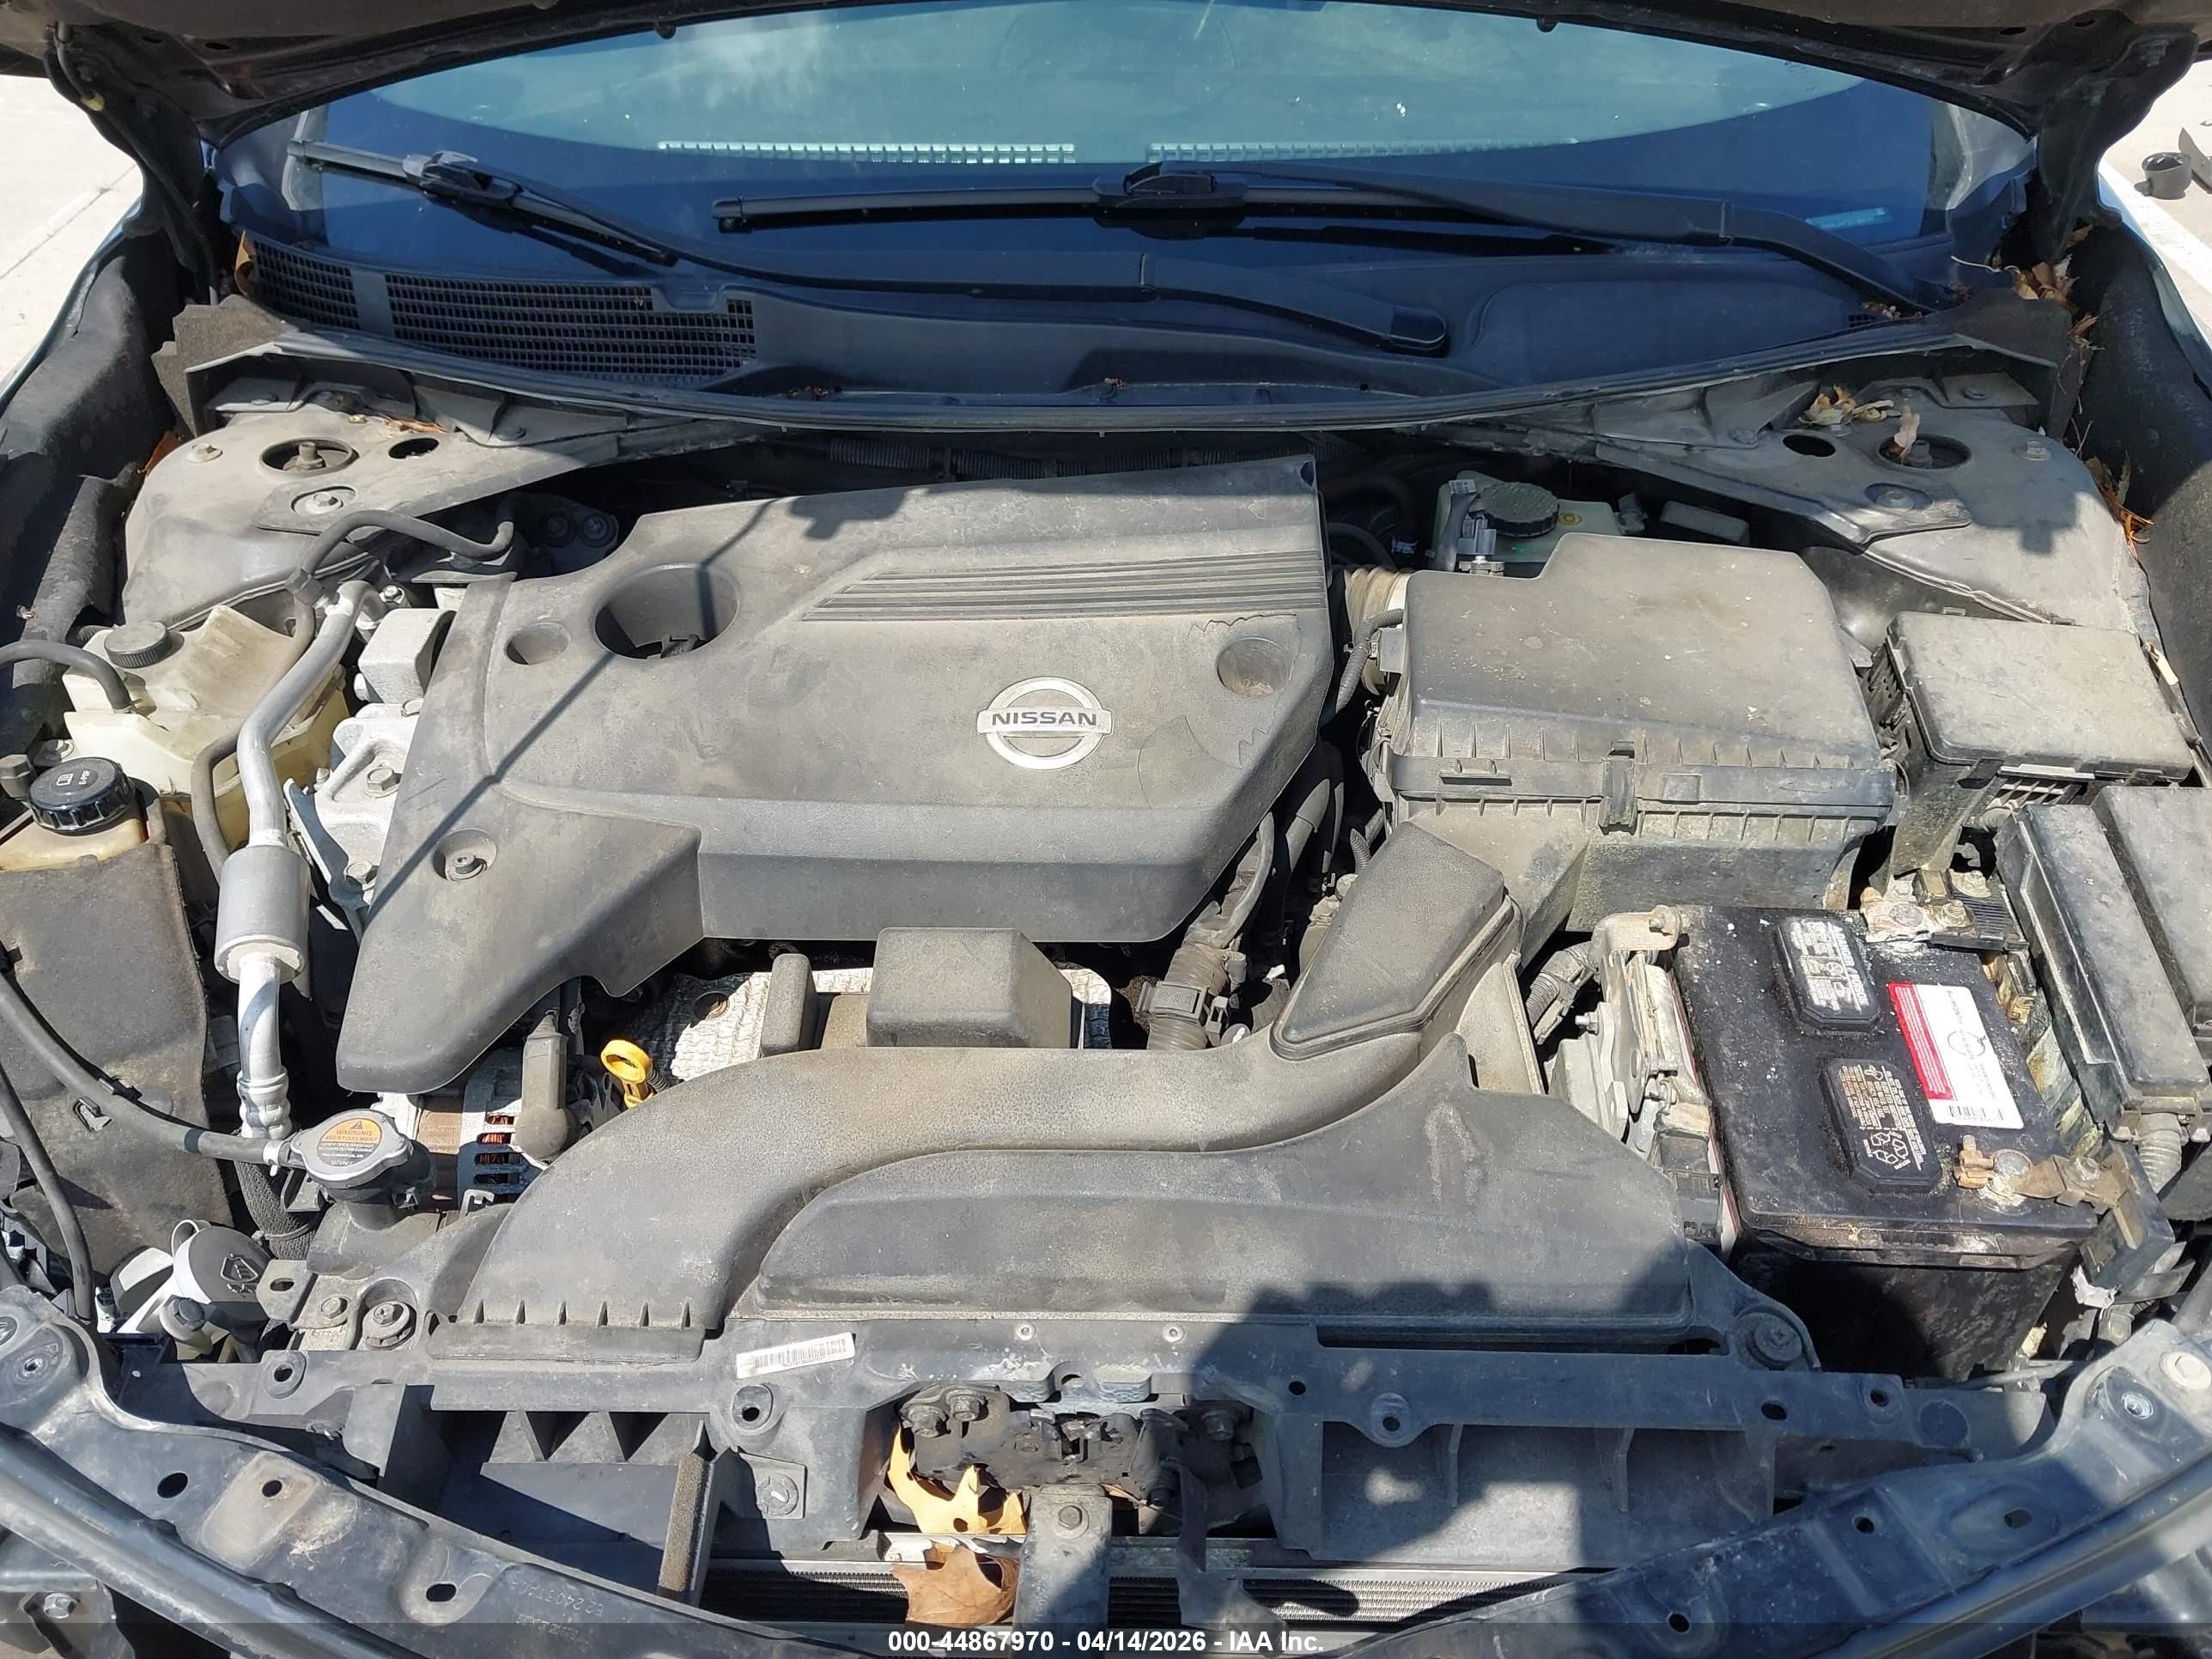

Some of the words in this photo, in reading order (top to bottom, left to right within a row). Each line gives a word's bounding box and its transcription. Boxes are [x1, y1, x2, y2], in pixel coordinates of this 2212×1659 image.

[992, 712, 1097, 726] NISSAN
[1836, 933, 1856, 967] DANGER
[1850, 974, 1869, 1006] POISON
